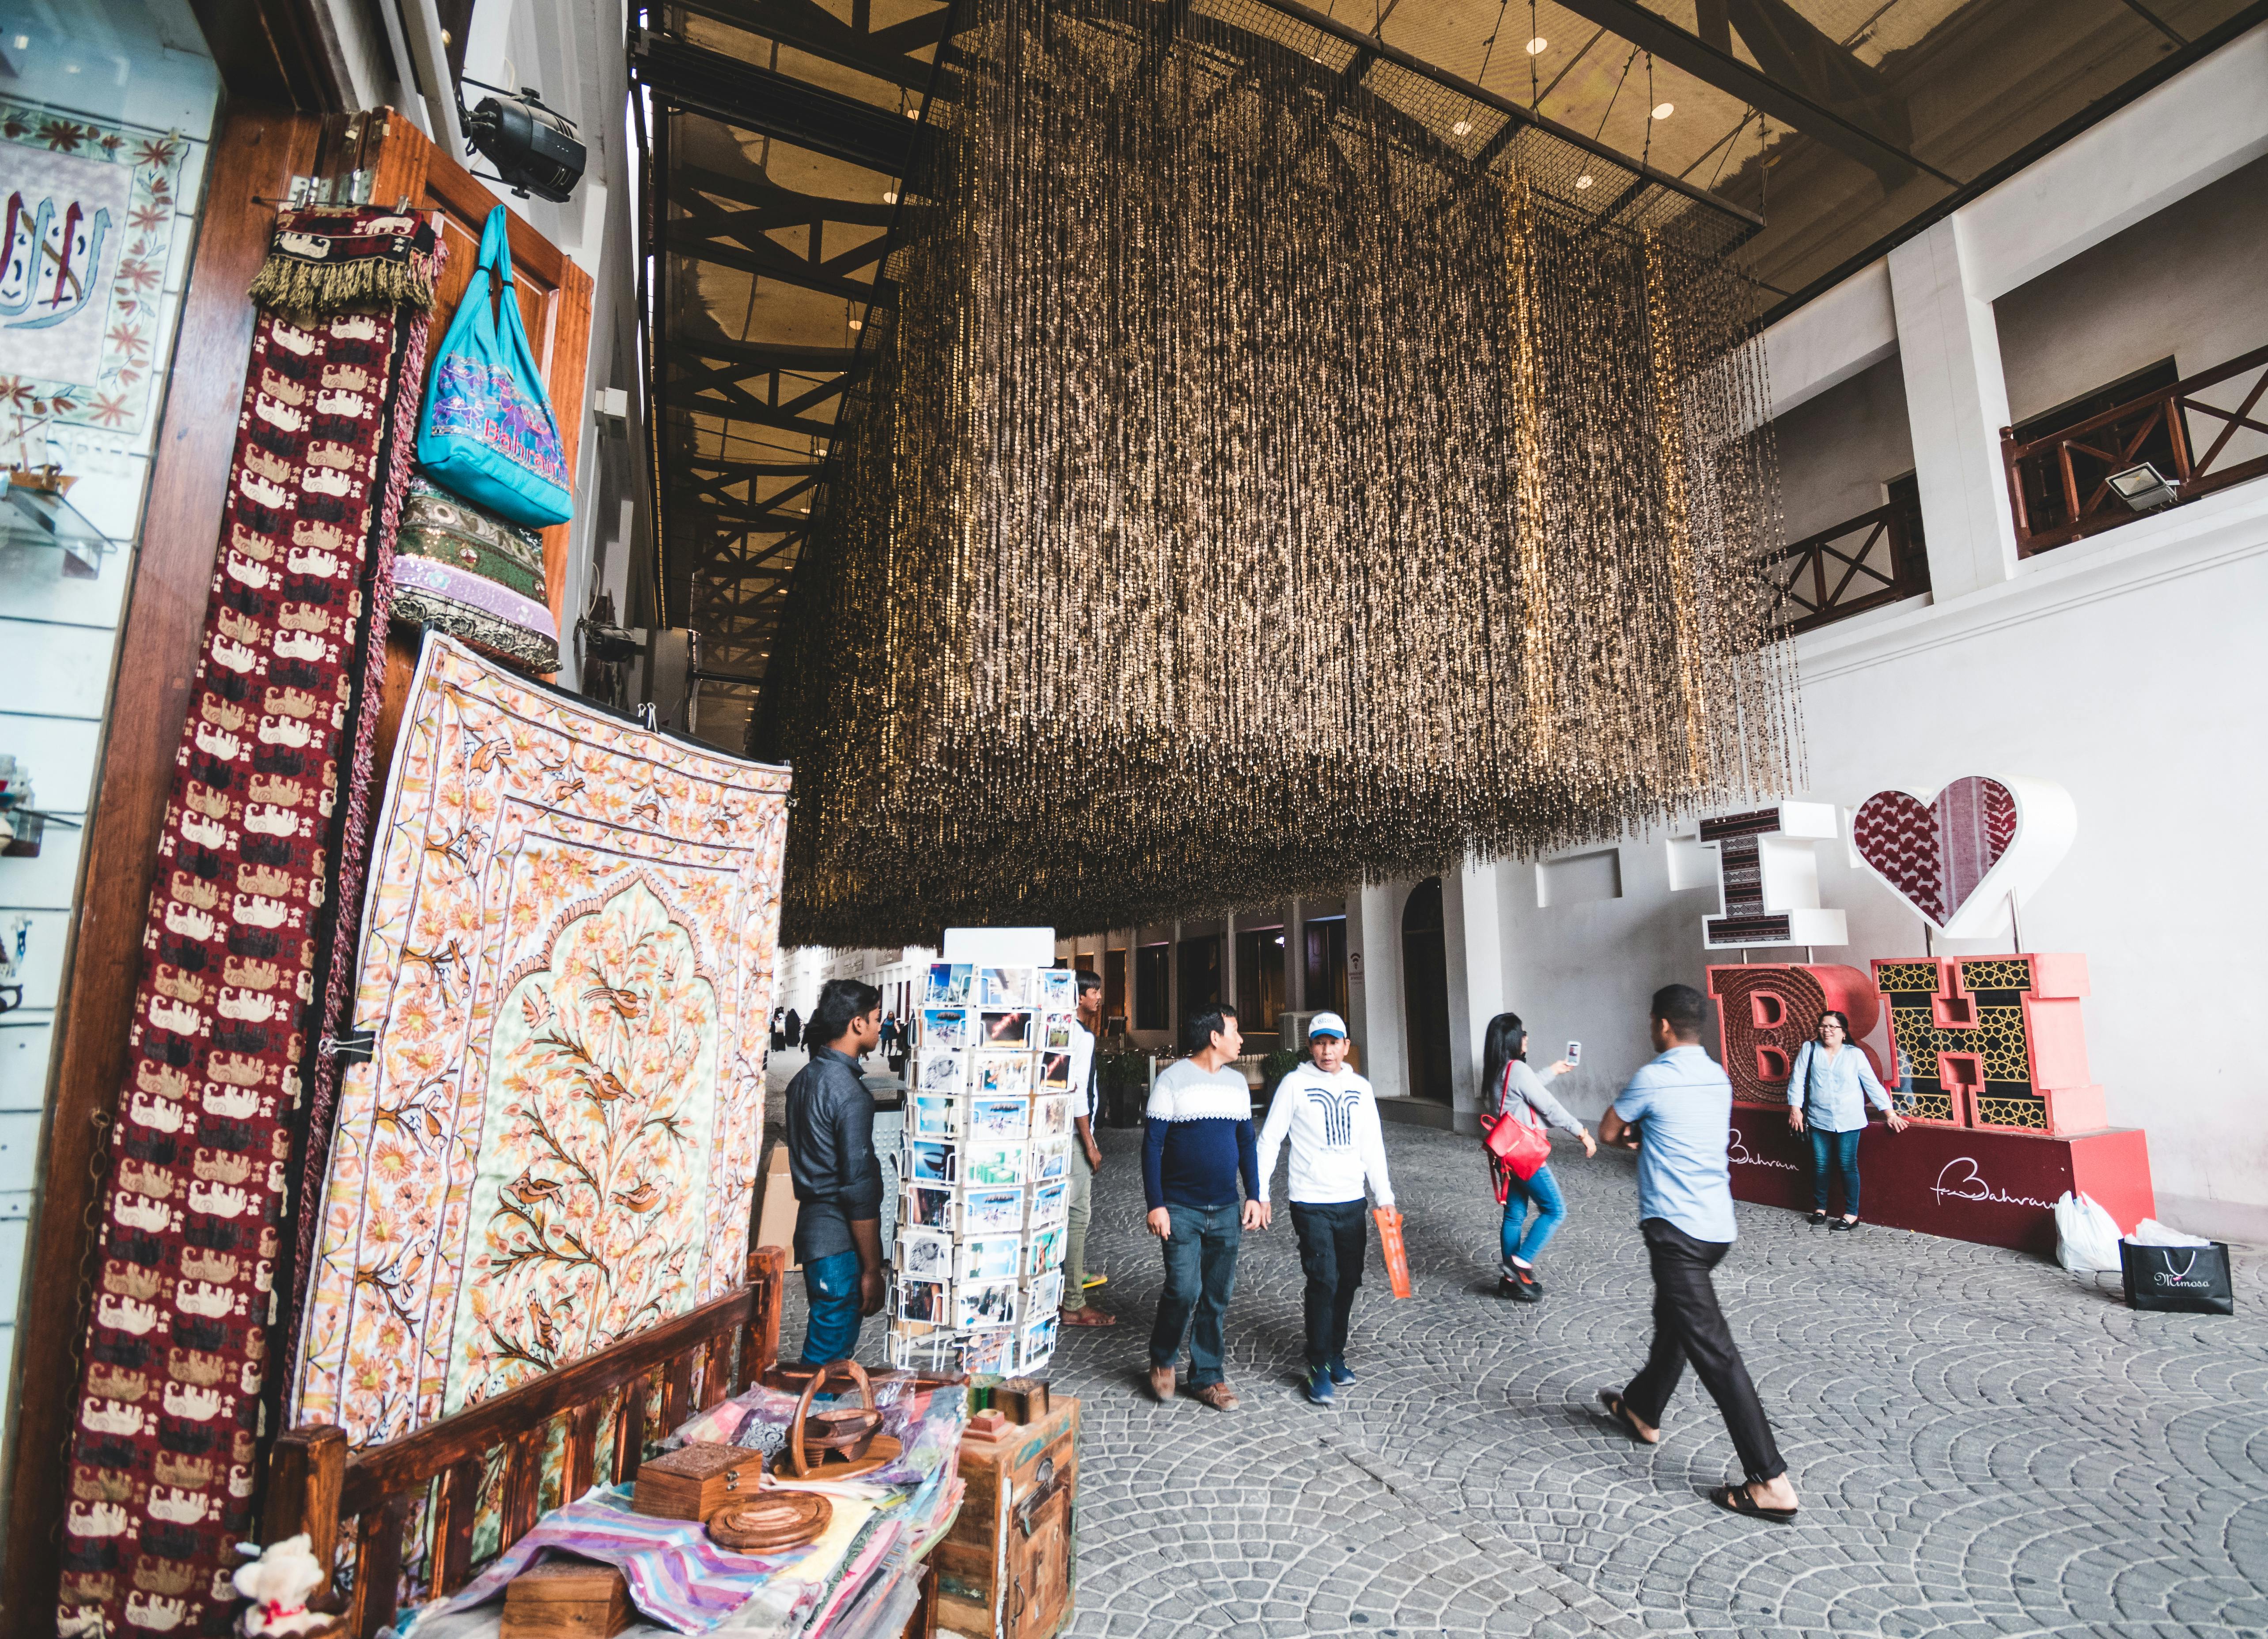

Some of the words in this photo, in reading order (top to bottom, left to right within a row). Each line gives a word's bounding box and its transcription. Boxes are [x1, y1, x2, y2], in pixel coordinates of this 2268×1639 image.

[484, 418, 562, 476] Bahrain
[1696, 801, 1809, 950] I
[2154, 1272, 2210, 1287] Mimosa
